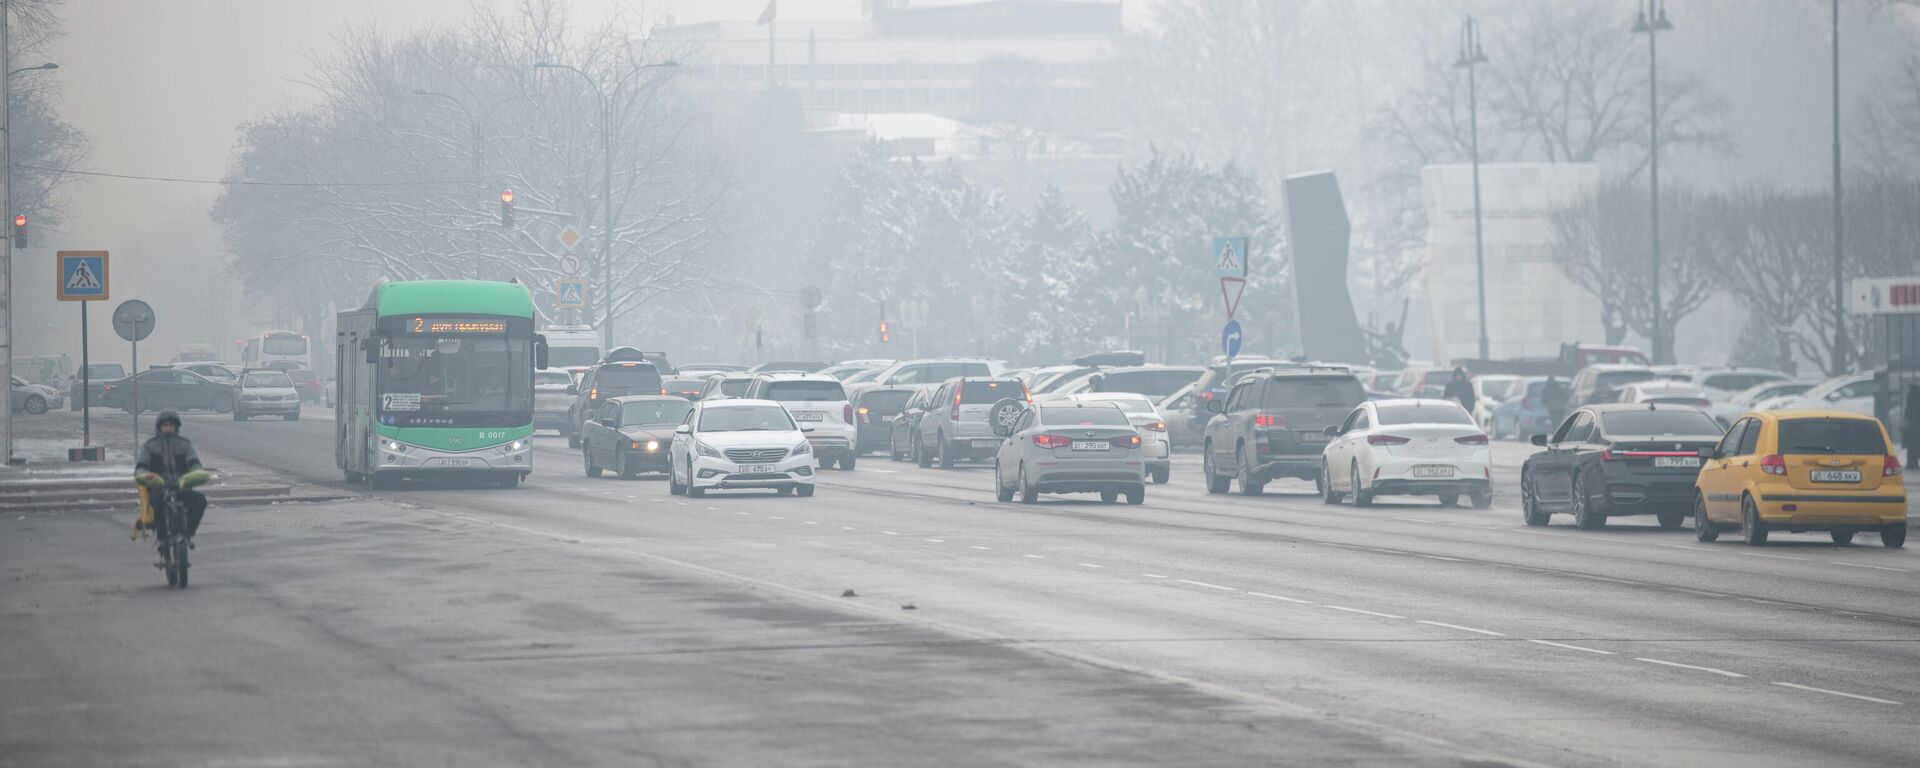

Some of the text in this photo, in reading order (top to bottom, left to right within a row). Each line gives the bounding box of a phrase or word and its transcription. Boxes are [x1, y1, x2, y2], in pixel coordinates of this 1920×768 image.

[415, 317, 424, 333] 2
[384, 395, 393, 411] 2
[487, 431, 506, 439] 0017
